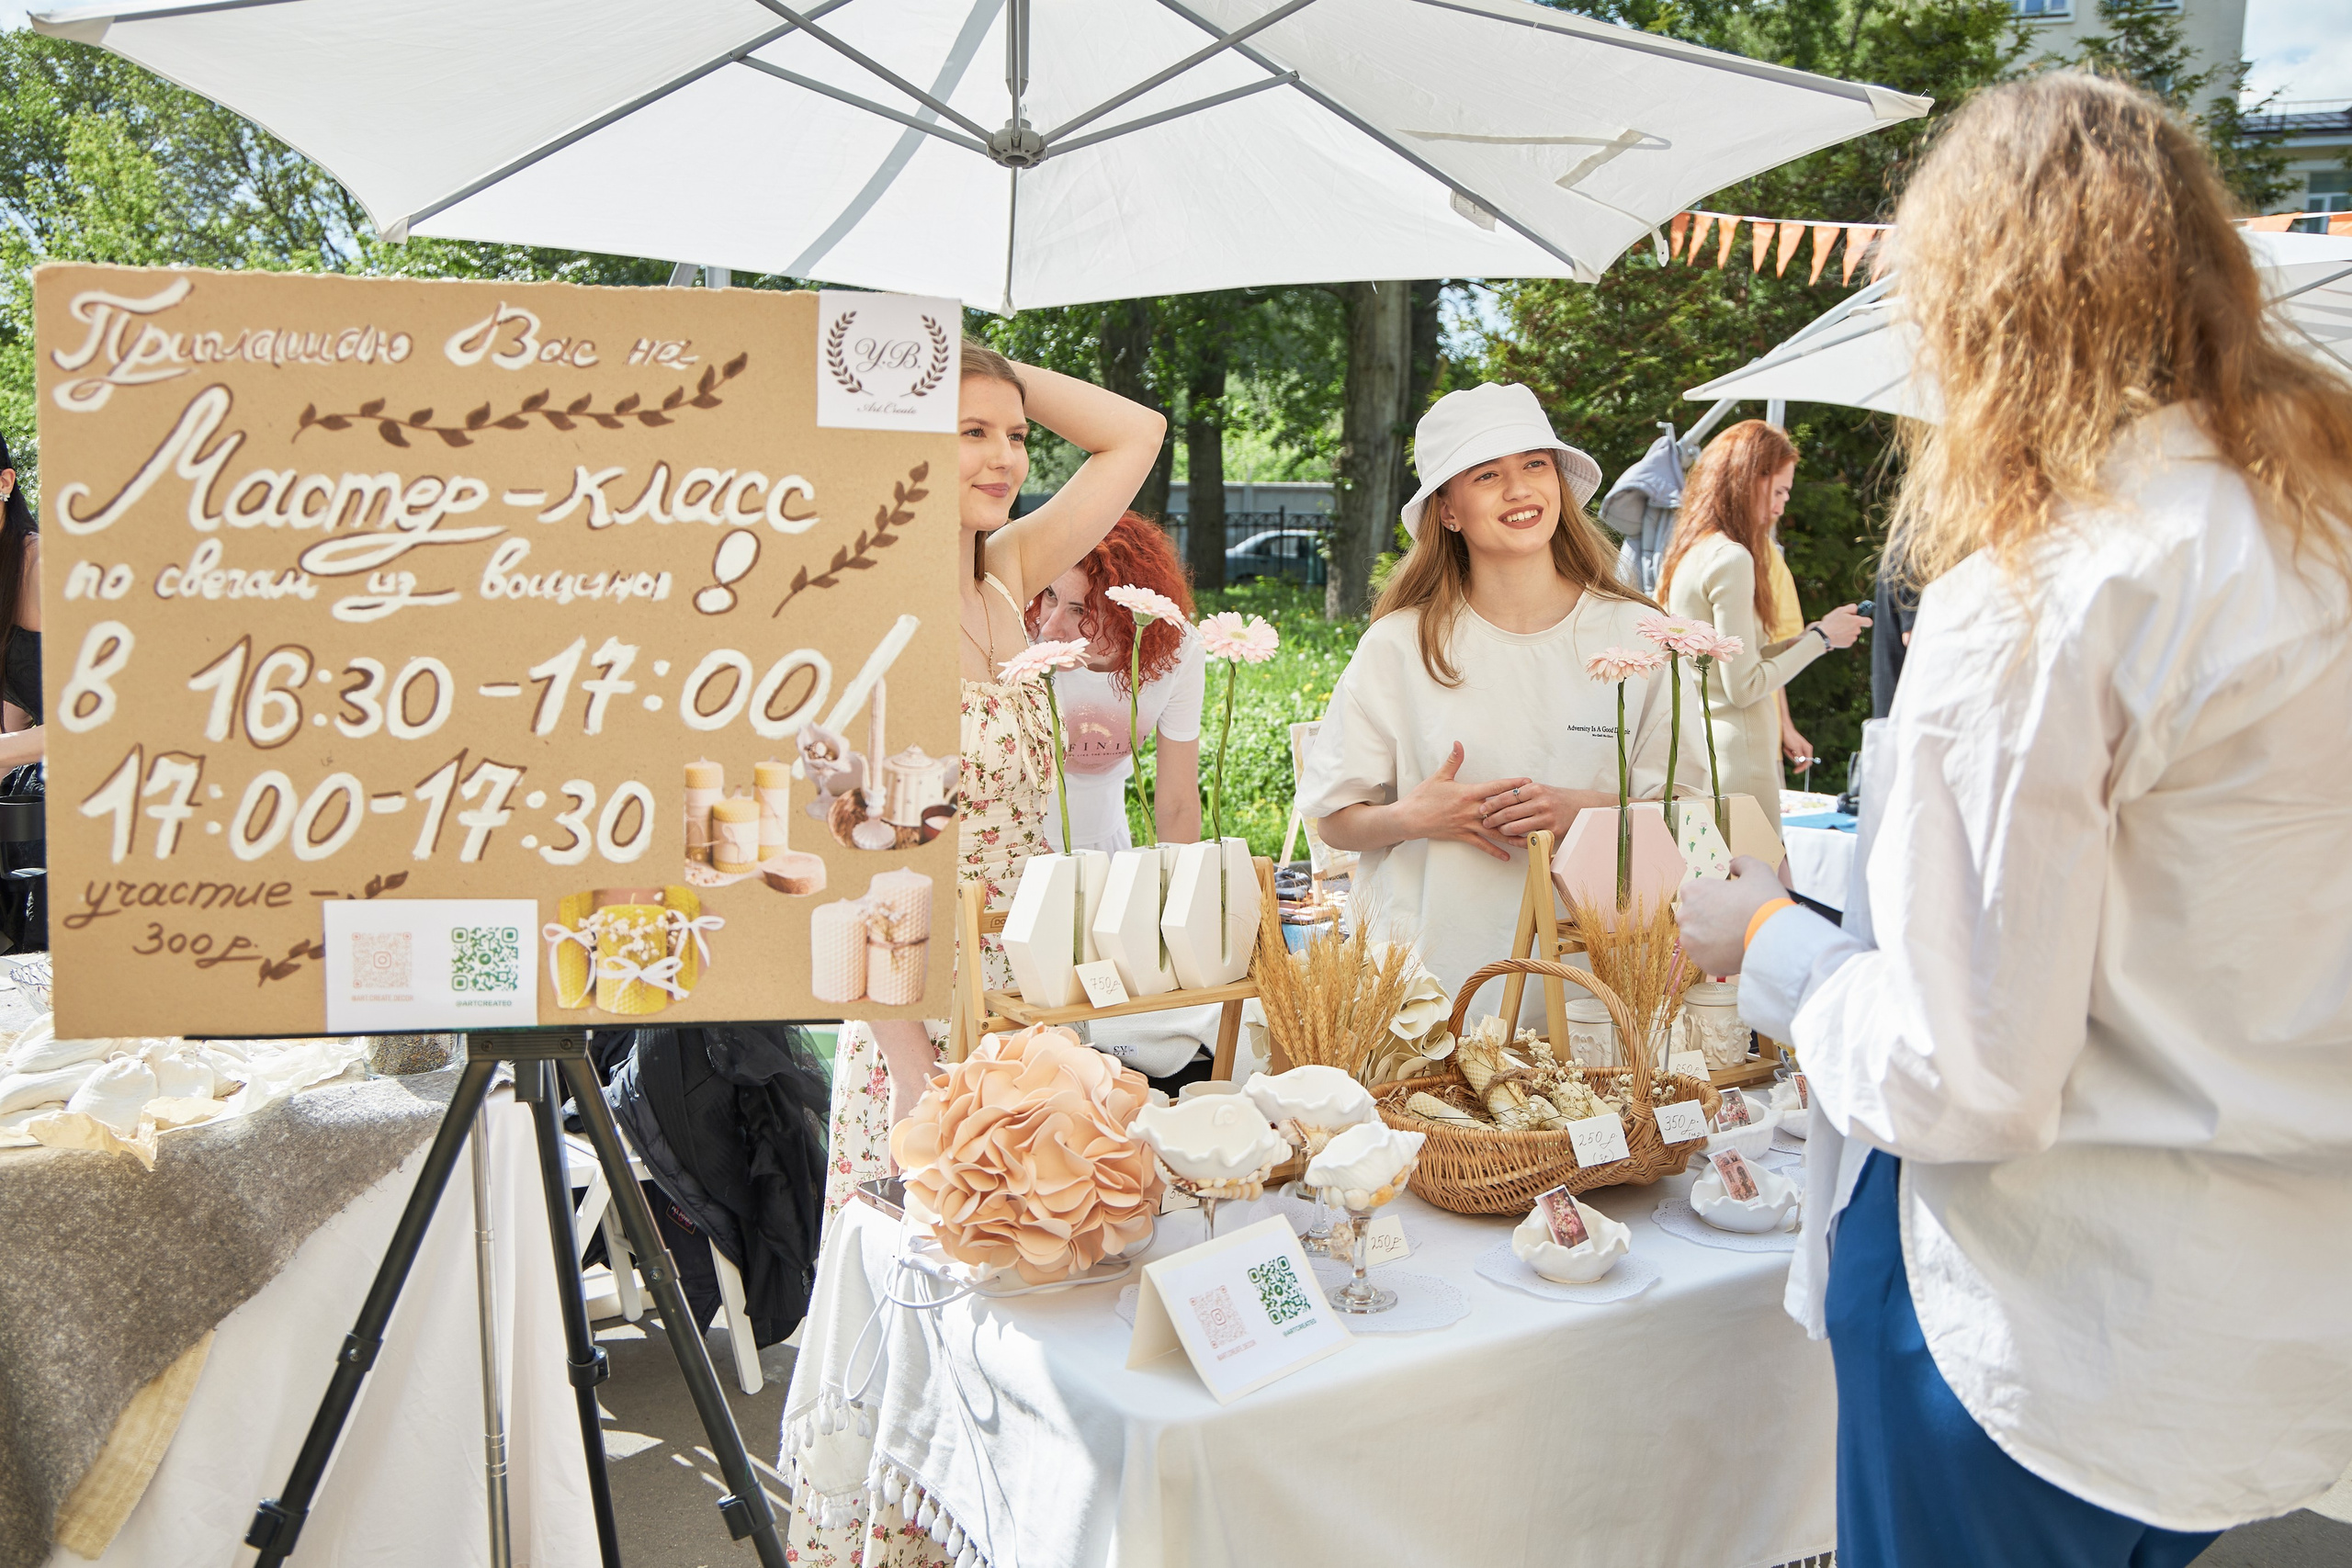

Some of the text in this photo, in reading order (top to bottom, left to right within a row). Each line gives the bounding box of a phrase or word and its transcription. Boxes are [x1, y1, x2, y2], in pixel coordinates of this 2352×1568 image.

[445, 300, 598, 370] Вас
[624, 334, 699, 370] на
[64, 561, 134, 601] по
[153, 537, 320, 600] свечам
[332, 570, 461, 622] из
[1566, 724, 1591, 733] Adversity
[62, 879, 293, 930] участие
